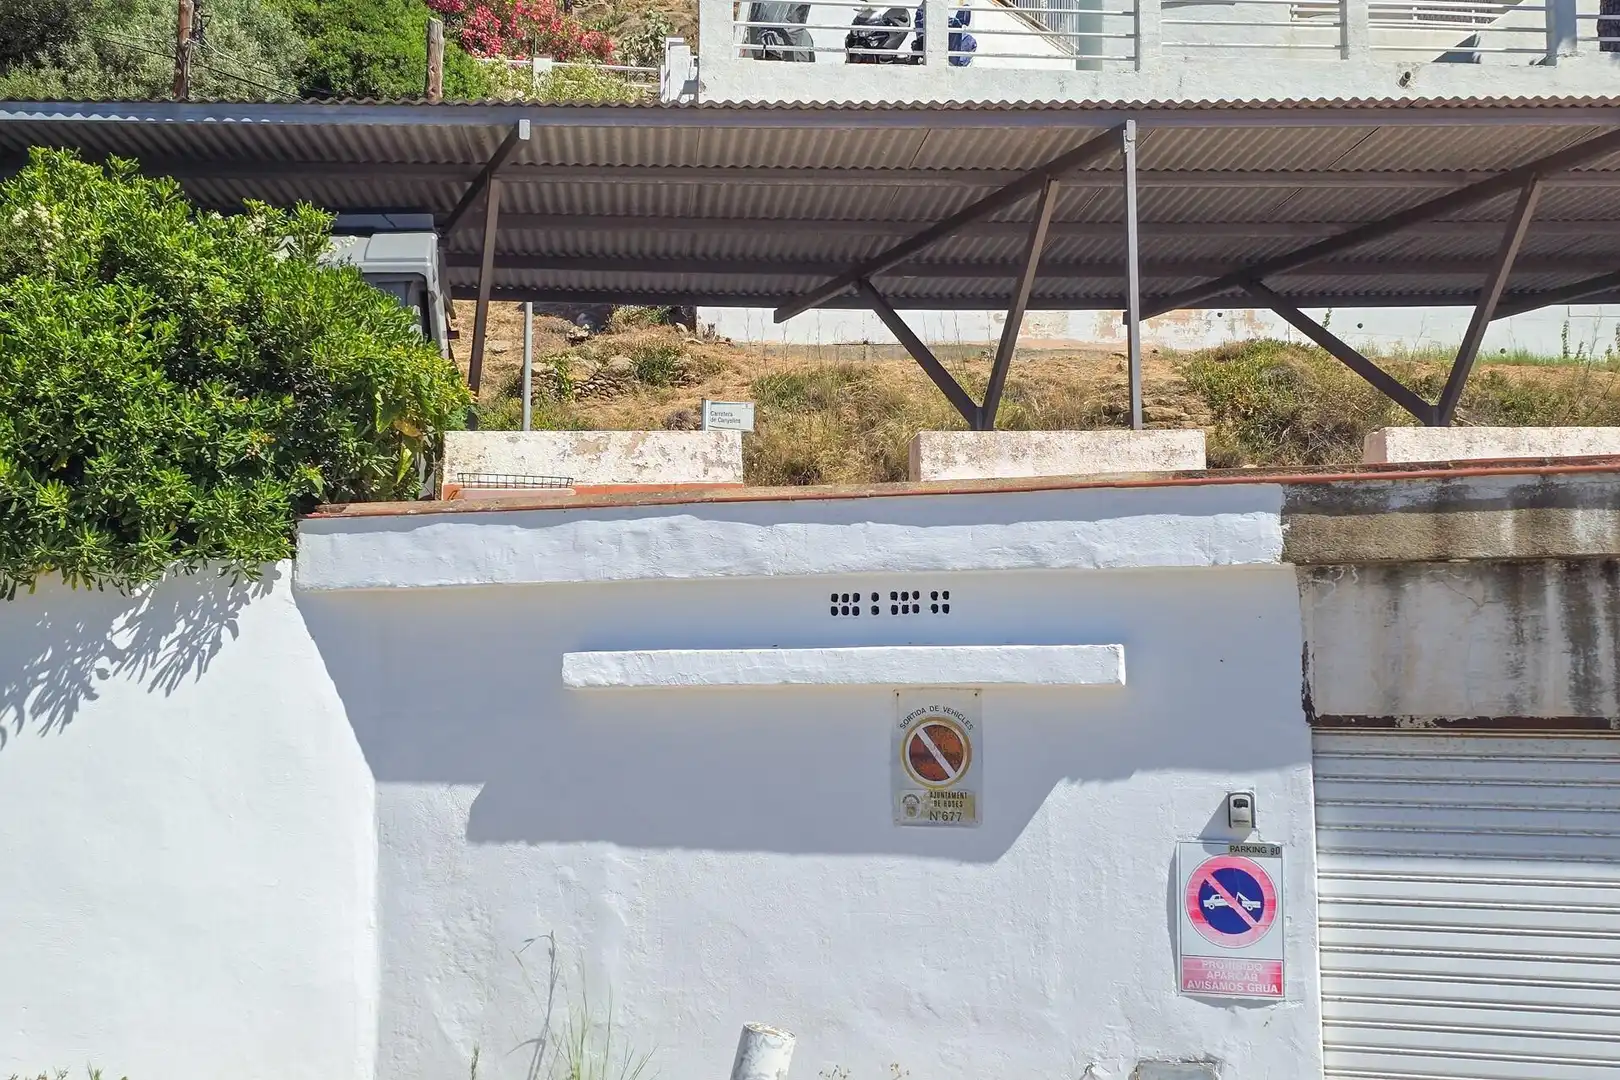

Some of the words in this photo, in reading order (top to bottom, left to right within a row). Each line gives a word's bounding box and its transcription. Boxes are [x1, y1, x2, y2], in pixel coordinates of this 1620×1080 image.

[900, 707, 927, 730] SORTIDA
[943, 706, 974, 731] VEHICLES
[929, 791, 968, 799] AJUNTAMENT
[933, 800, 941, 808] DE
[1230, 845, 1267, 854] PARKING
[1206, 970, 1258, 981] APARCAR
[1187, 980, 1244, 992] AVISAMOS
[1247, 982, 1278, 993] GRUA
